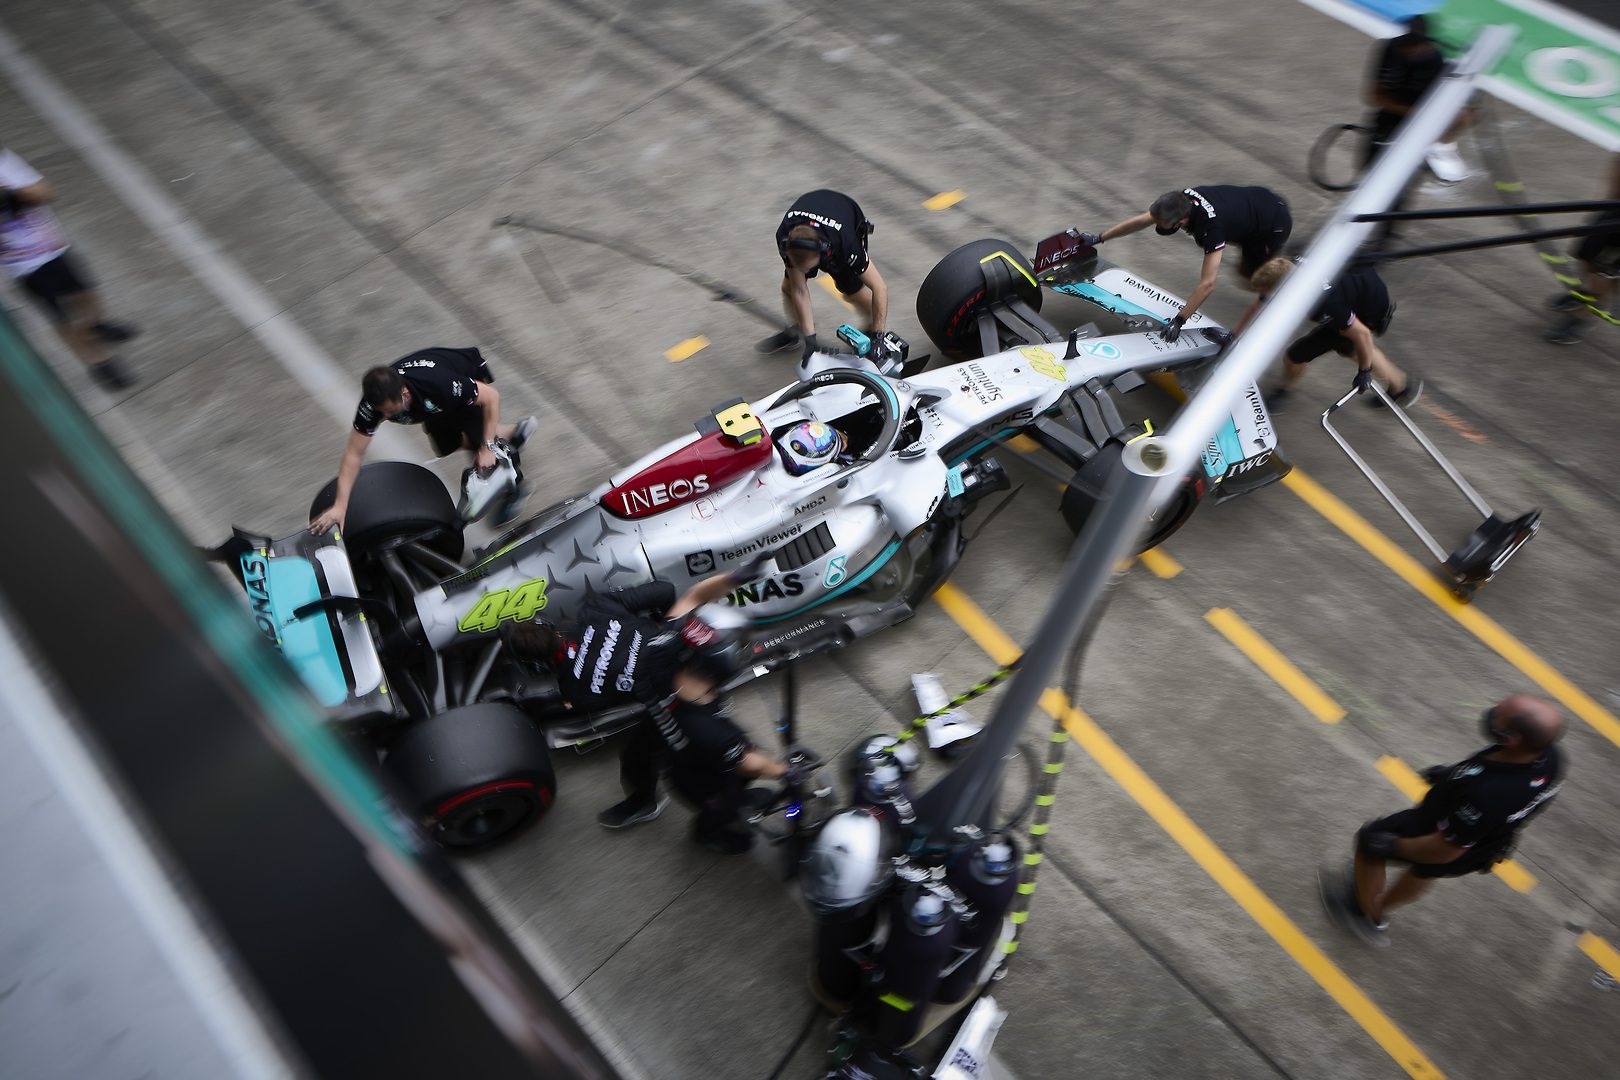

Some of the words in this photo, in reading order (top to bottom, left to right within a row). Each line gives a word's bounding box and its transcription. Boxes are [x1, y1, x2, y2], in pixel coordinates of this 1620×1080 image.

[787, 210, 843, 232] PETRONAS
[1039, 245, 1079, 269] INEOS
[1123, 276, 1185, 312] eamViewer
[957, 367, 989, 406] PETRONAS
[967, 362, 1004, 402] Syntium
[1244, 386, 1267, 428] TeamVi
[1226, 451, 1273, 478] IWC
[620, 474, 711, 516] INEOS
[720, 523, 803, 562] TeamViewer
[458, 577, 548, 633] 44
[763, 618, 826, 649] PERFORMANCE
[590, 619, 622, 695] PETRONAS
